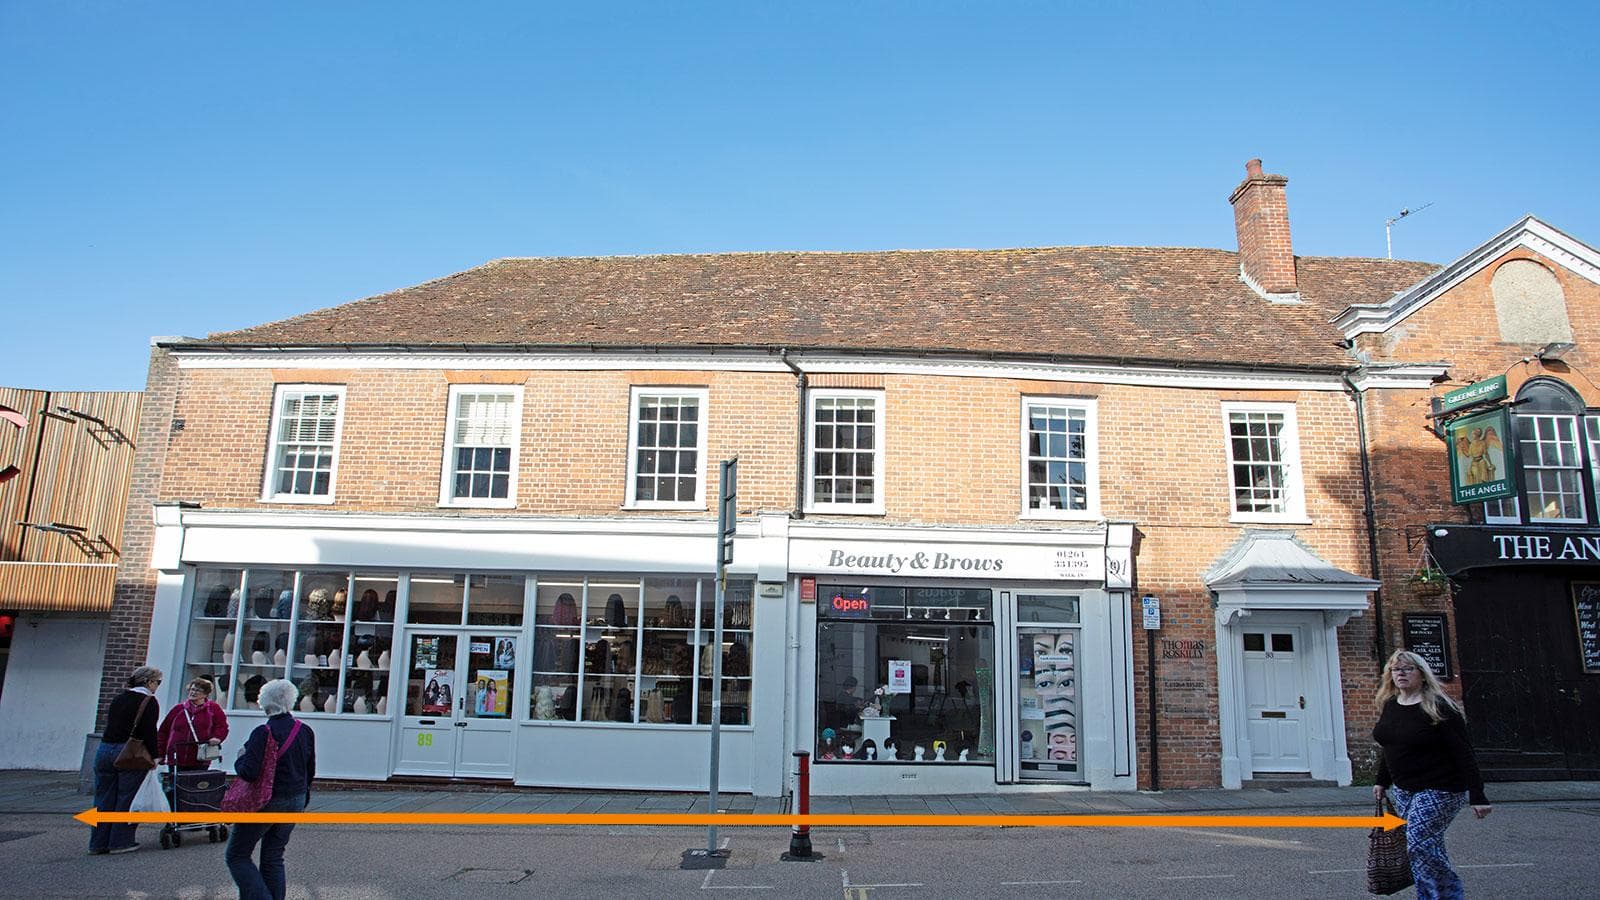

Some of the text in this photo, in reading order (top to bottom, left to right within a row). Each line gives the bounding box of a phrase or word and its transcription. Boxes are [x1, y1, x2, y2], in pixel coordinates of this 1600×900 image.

[1448, 382, 1500, 404] GREENE KING
[1460, 483, 1506, 498] THE ANGEL
[1492, 535, 1553, 559] THE
[828, 549, 1003, 573] Beauty & Brows
[833, 596, 868, 612] Open
[417, 733, 432, 746] 89
